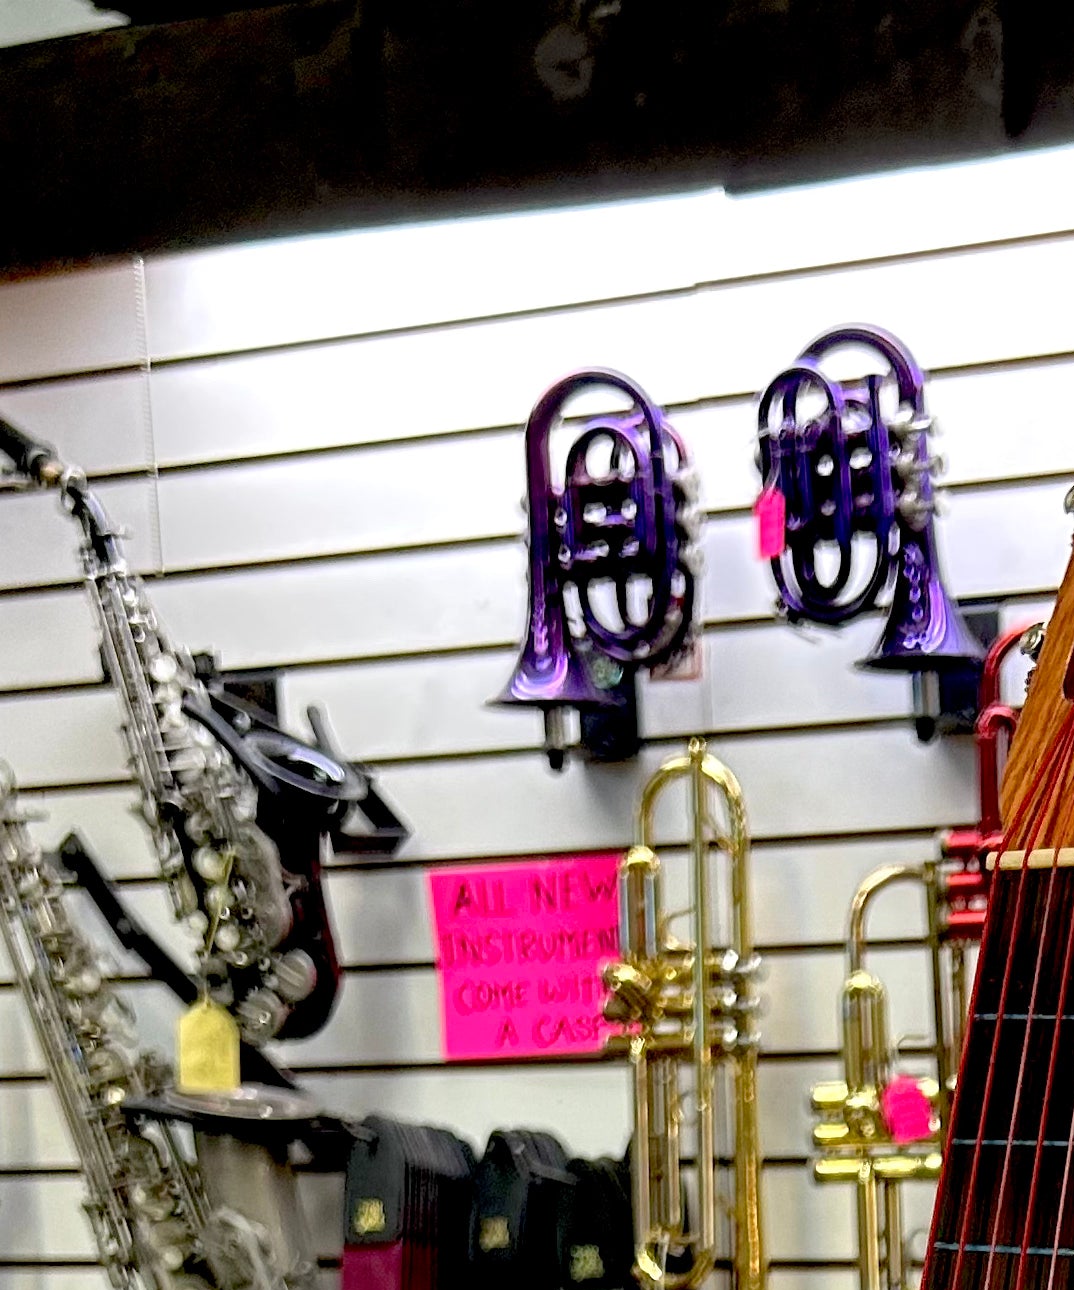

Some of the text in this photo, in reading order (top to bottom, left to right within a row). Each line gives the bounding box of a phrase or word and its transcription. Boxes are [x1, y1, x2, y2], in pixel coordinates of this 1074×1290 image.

[452, 871, 618, 918] ALL NEW
[440, 925, 620, 969] INSTRUMEN
[454, 977, 529, 1015] COME
[495, 1016, 520, 1047] A
